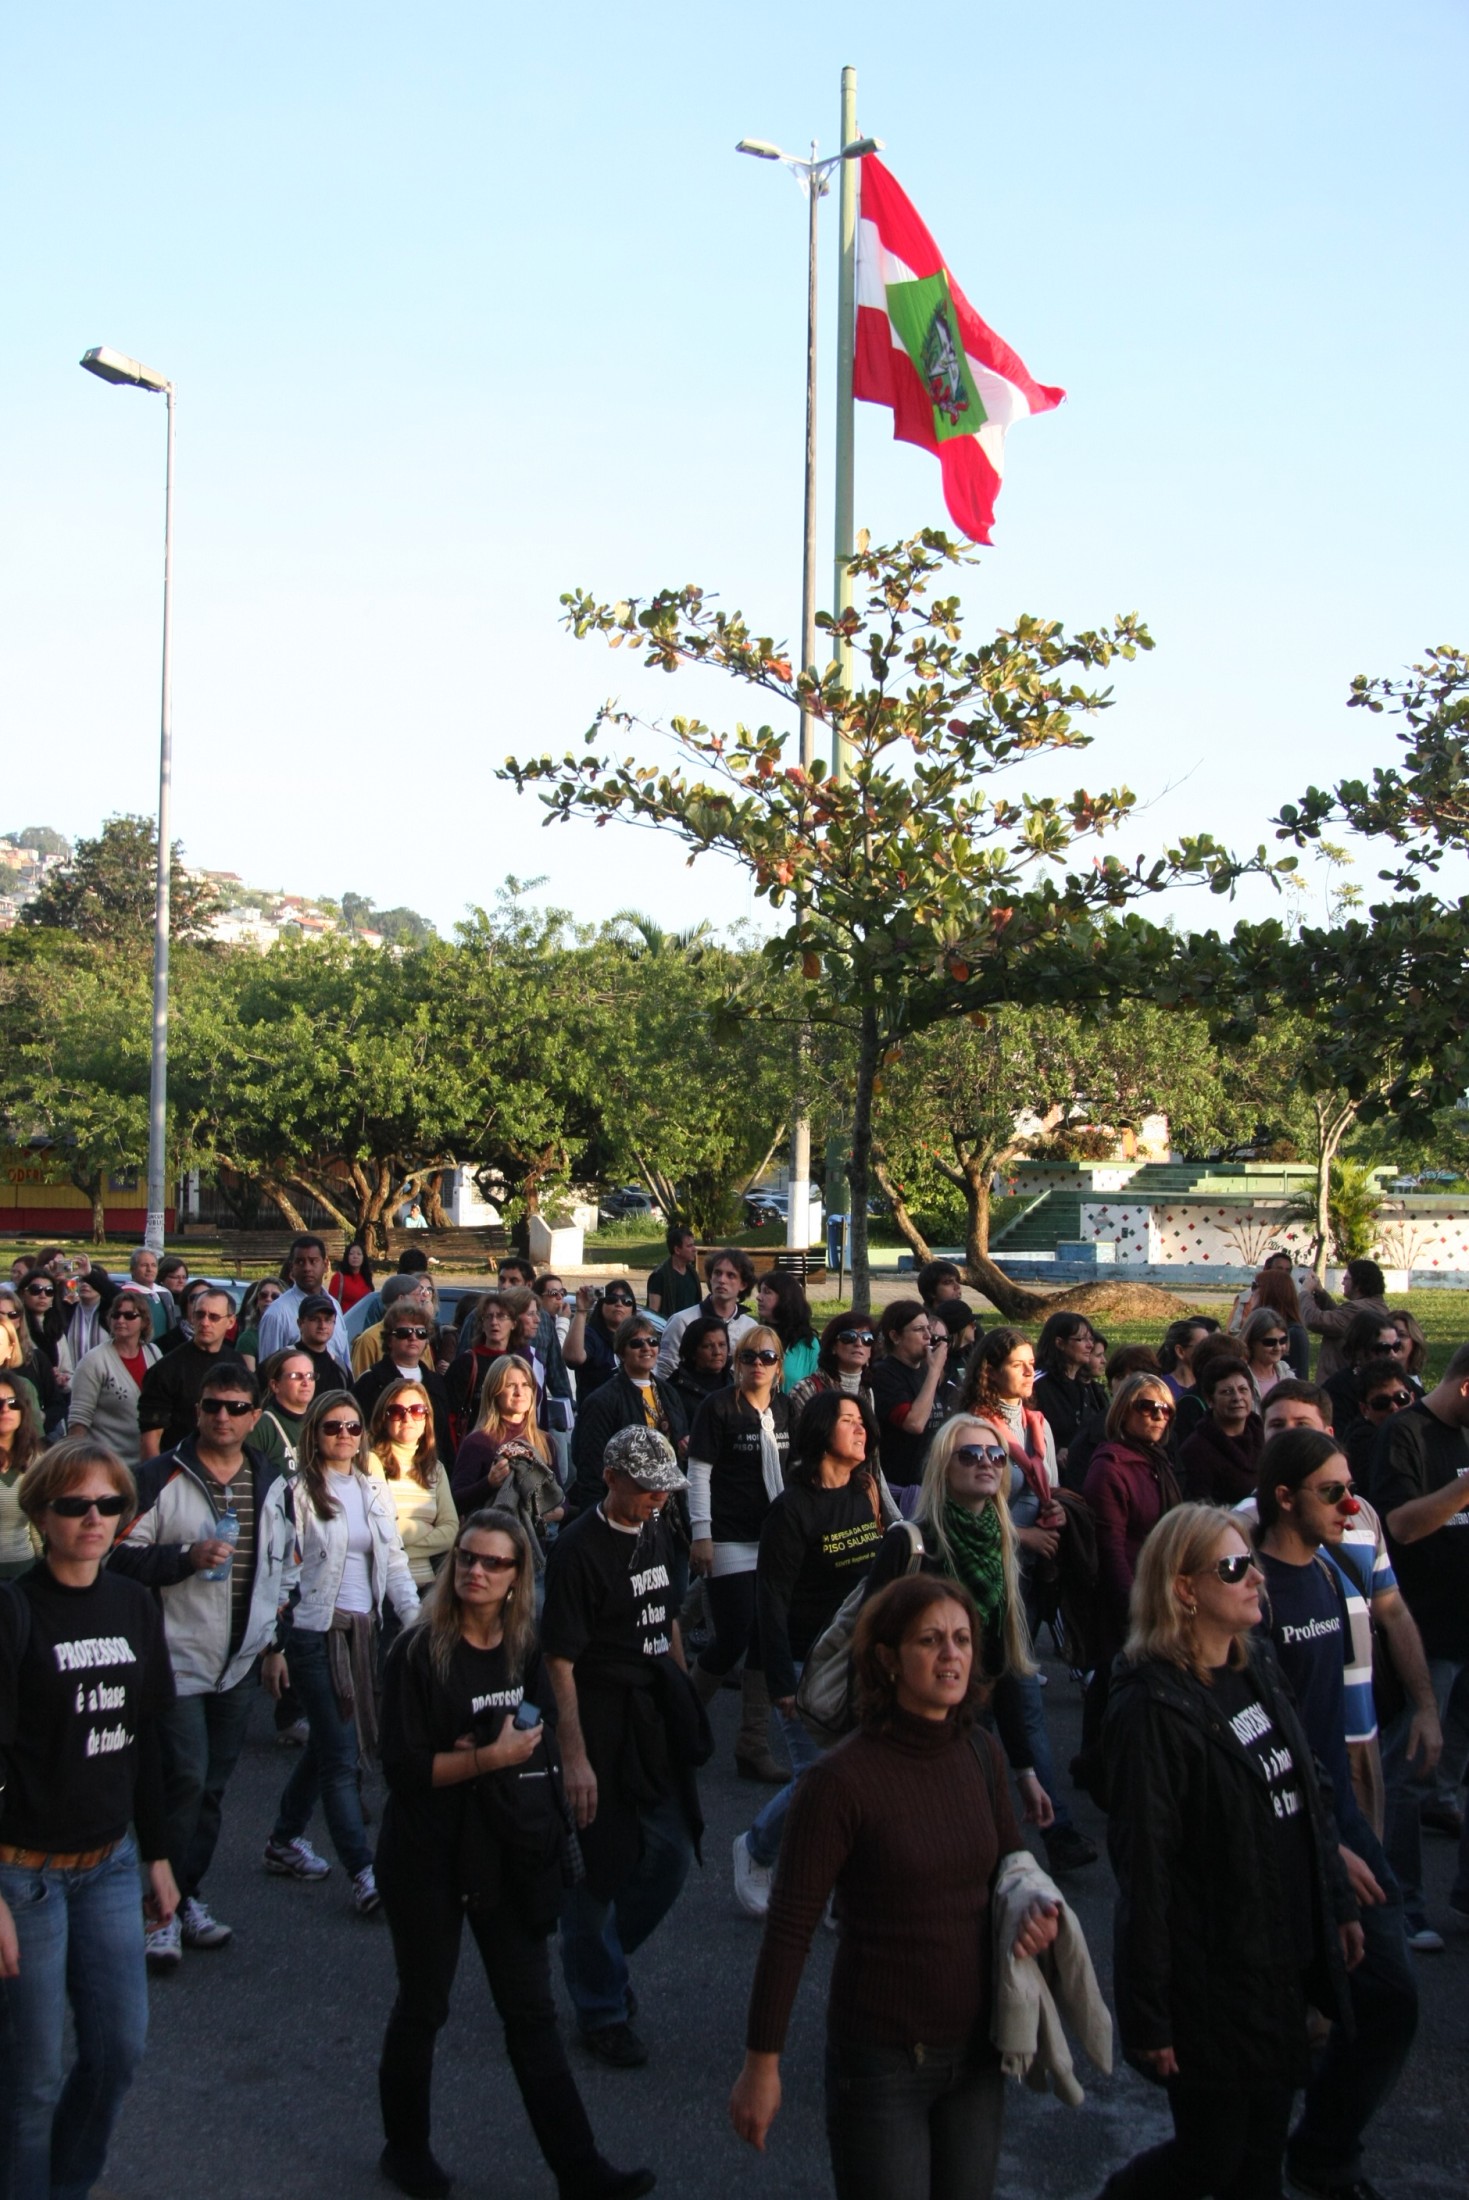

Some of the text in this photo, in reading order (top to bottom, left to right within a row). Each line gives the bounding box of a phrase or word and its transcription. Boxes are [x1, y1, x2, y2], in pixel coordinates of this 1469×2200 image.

[823, 1531, 880, 1553] PISO SALARIAL
[647, 1602, 666, 1624] base
[1281, 1616, 1340, 1644] Professor
[53, 1636, 137, 1671] PROFESSOR
[88, 1688, 98, 1712] a
[97, 1681, 126, 1711] base
[86, 1726, 100, 1757] de
